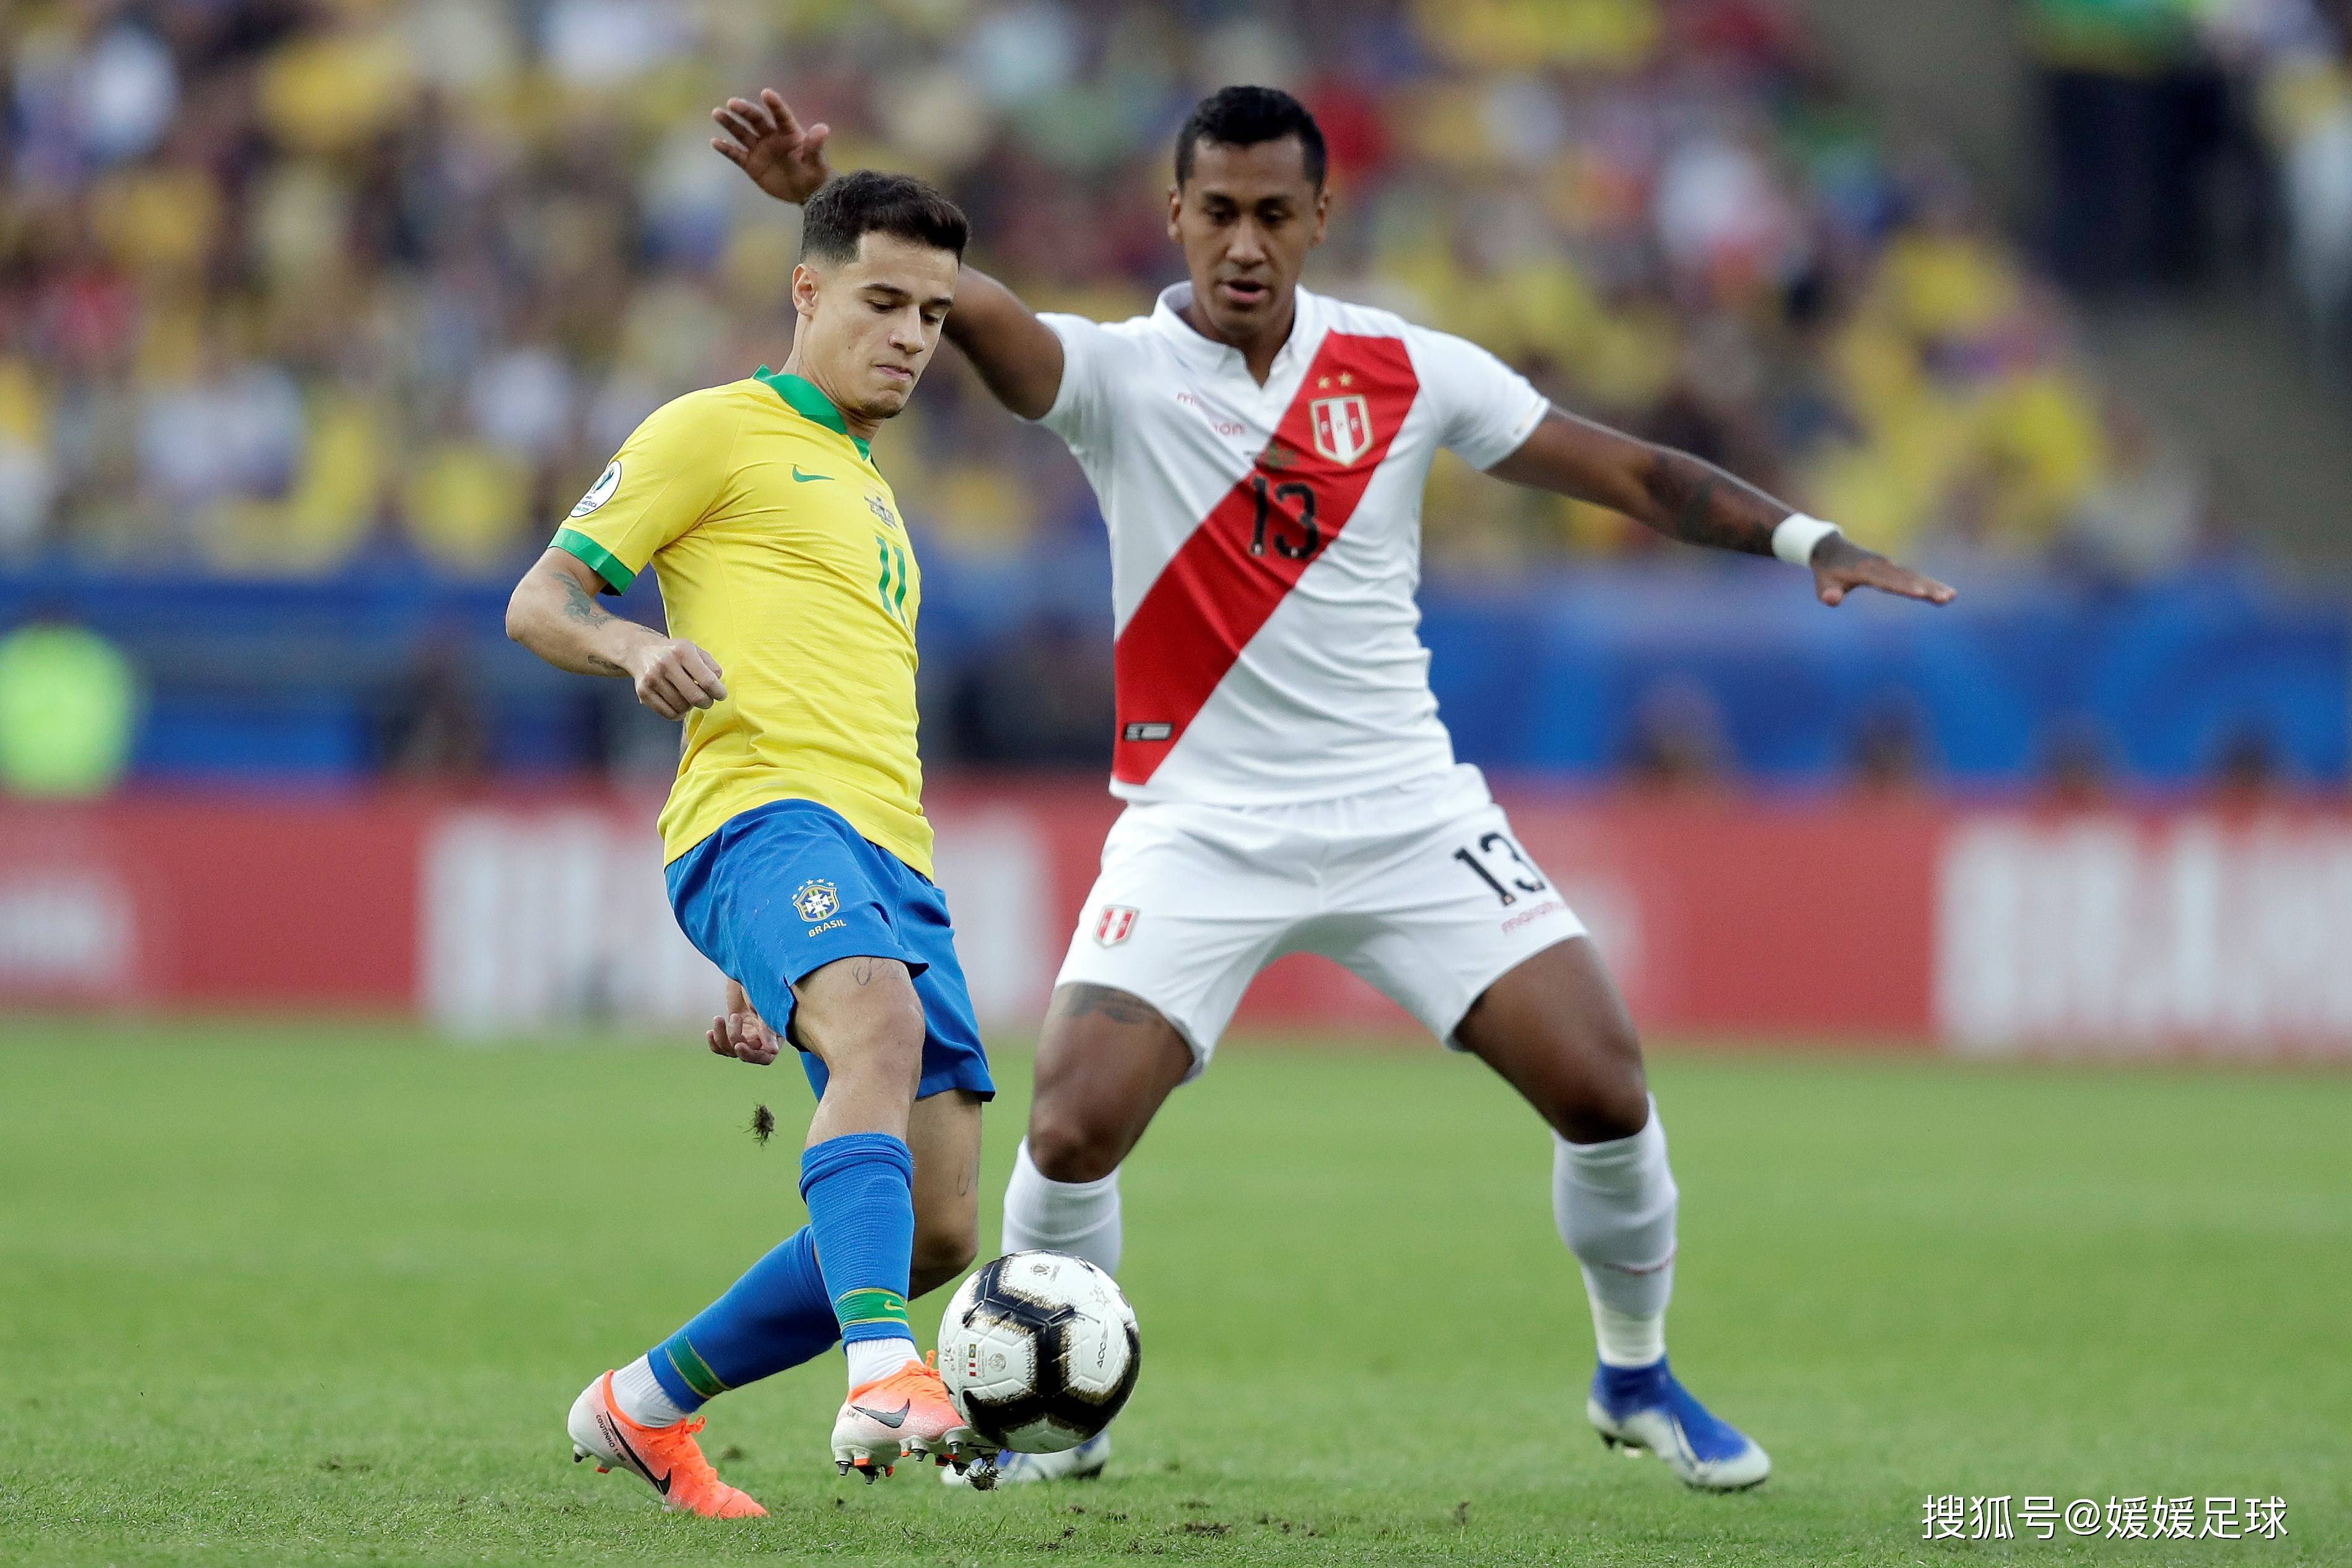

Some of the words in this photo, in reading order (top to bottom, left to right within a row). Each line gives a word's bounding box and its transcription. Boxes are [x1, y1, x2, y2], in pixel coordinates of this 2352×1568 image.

[1250, 476, 1320, 559] 13
[875, 535, 911, 634] 11
[1454, 833, 1545, 906] 13
[808, 919, 847, 938] BRASIL
[596, 1414, 615, 1448] COUTINHO
